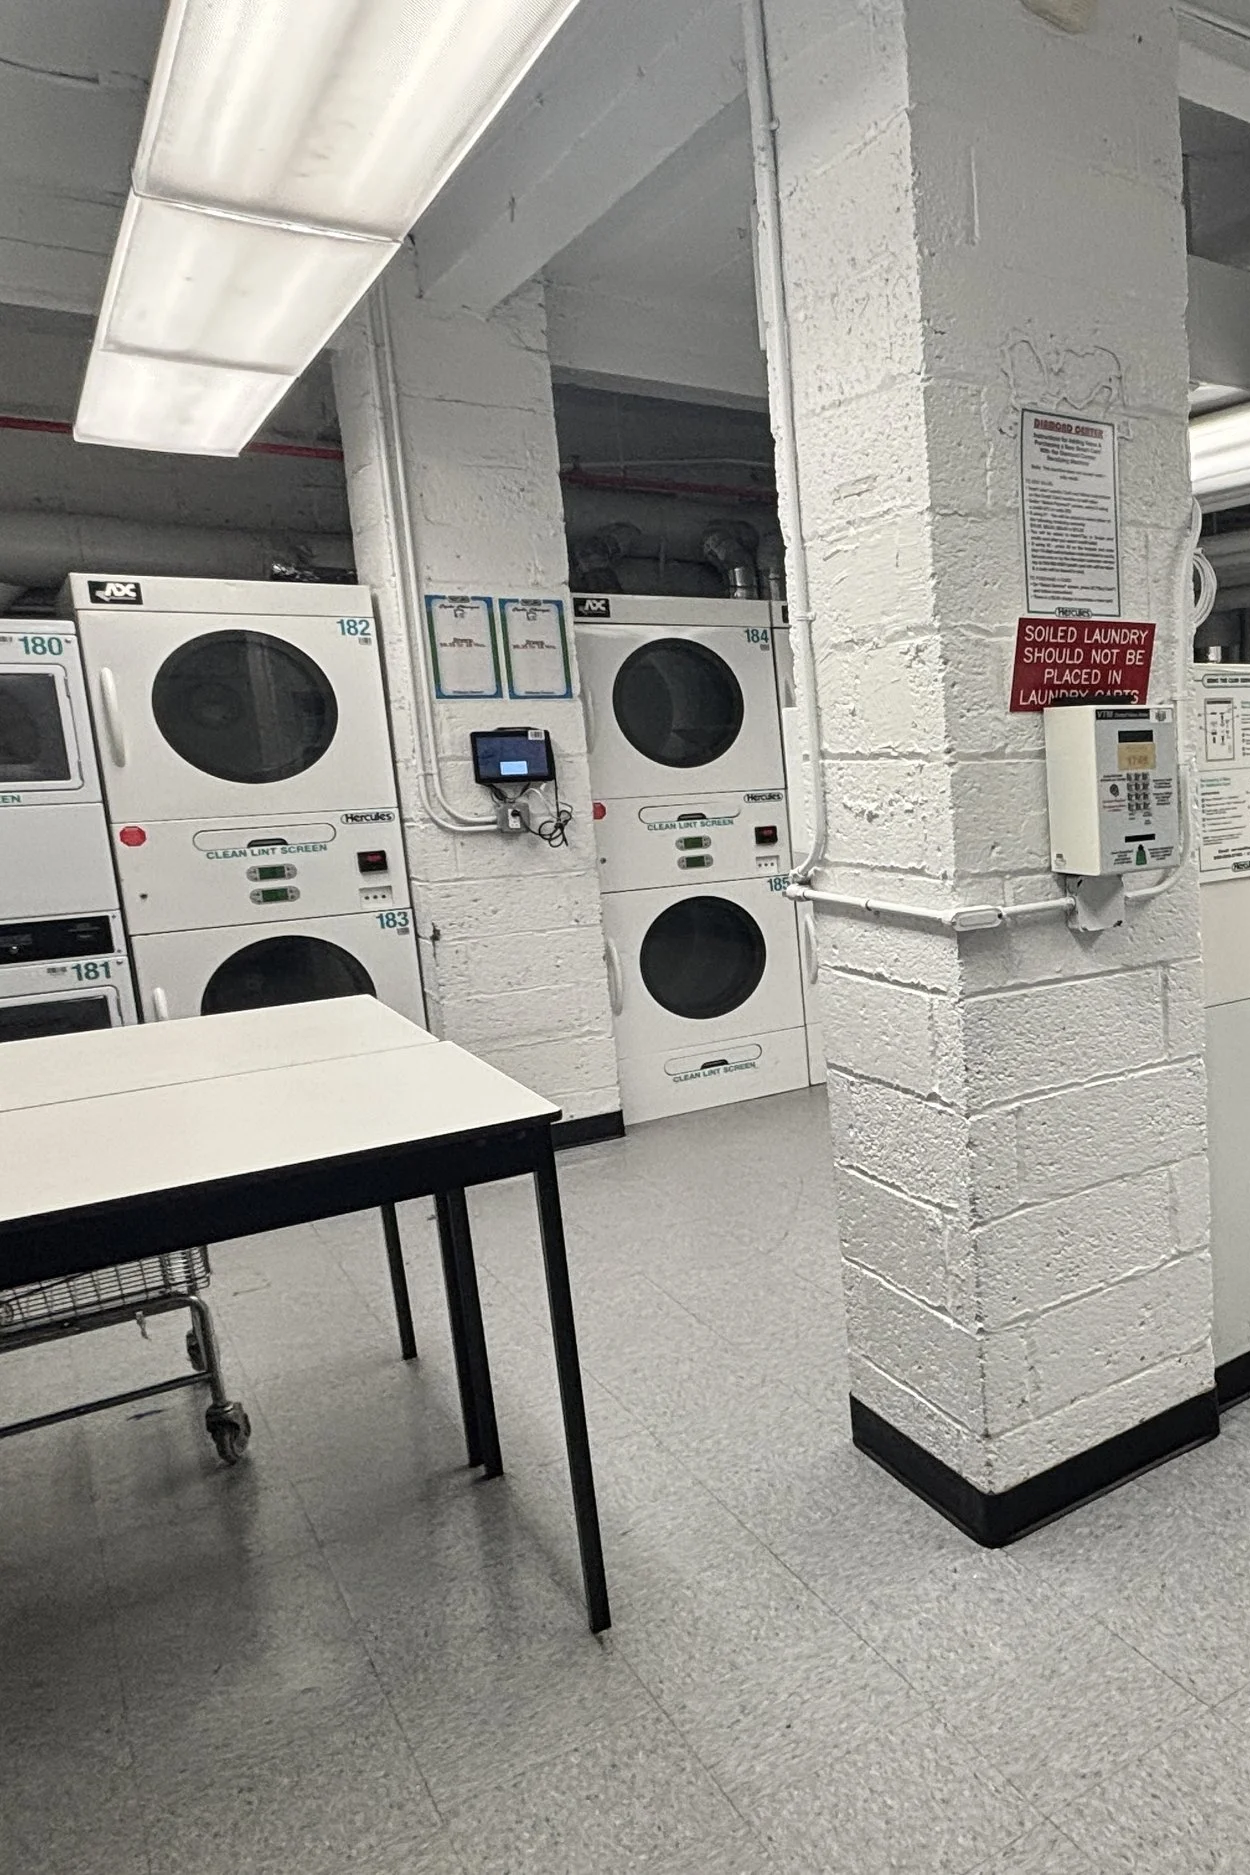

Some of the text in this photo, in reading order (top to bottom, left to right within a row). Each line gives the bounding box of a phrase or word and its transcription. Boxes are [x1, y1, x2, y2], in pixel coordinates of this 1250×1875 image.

[337, 619, 370, 636] 182
[745, 629, 769, 643] 184
[1024, 625, 1148, 645] SOILED LAUNDRY
[19, 636, 63, 655] 180
[1023, 647, 1145, 665] SHOULD NOT BE
[1044, 669, 1122, 685] PLACED IN
[746, 793, 781, 801] Hercules
[344, 813, 392, 823] Hercules
[647, 818, 734, 831] CLEAN LINT SCREEN
[206, 843, 328, 860] CLEAN LINT SCREEN
[375, 912, 409, 929] 183
[71, 961, 111, 981] 181
[672, 1061, 756, 1083] CLEAN LINT SCREEN
